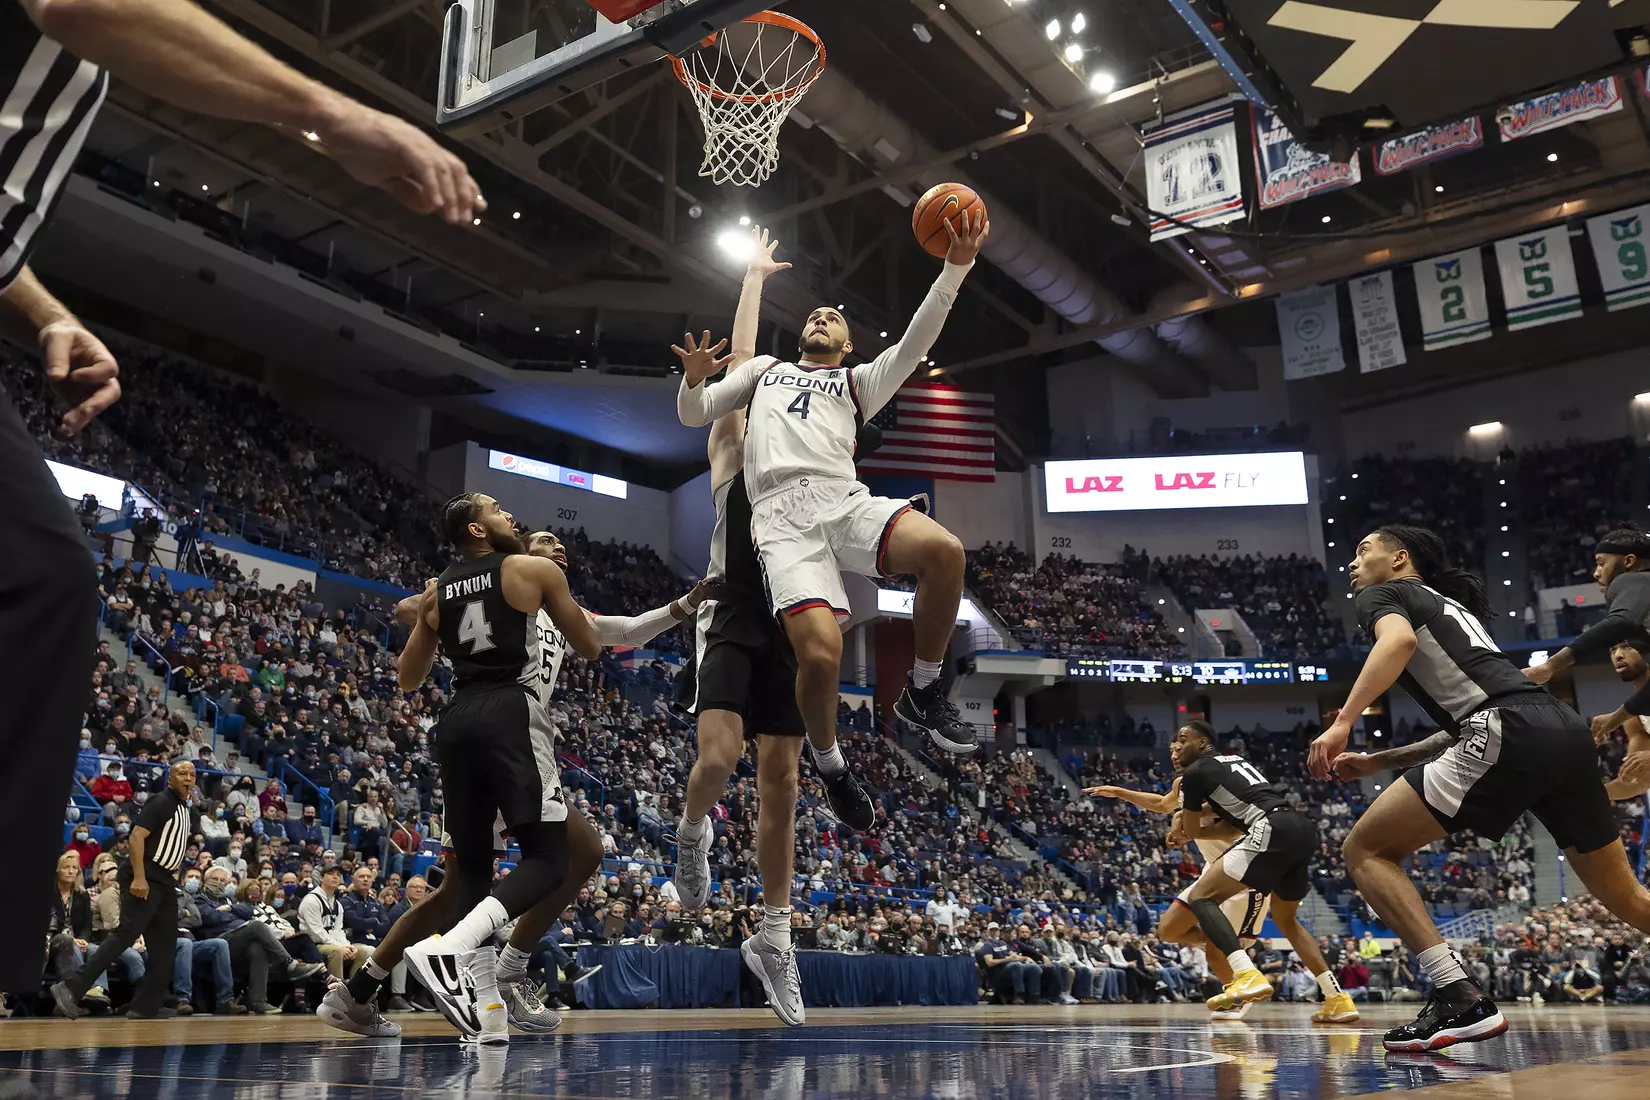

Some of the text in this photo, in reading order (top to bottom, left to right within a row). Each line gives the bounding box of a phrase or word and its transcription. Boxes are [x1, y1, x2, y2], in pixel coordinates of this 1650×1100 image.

[1162, 153, 1225, 206] 12
[1618, 240, 1648, 280] 9
[1523, 262, 1554, 299] 5
[1440, 284, 1467, 323] 2
[763, 375, 845, 398] UCONN
[787, 391, 812, 420] 4
[1065, 475, 1124, 494] LAZ
[1154, 471, 1260, 491] LAZ FLY
[557, 507, 578, 521] 207
[1051, 536, 1072, 548] 232
[1217, 538, 1239, 551] 233
[445, 572, 493, 600] BYNUM
[457, 599, 497, 655] 4
[541, 647, 555, 685] 5
[964, 700, 981, 711] 107
[1464, 710, 1490, 760] FRIARS
[1230, 761, 1271, 786] 11
